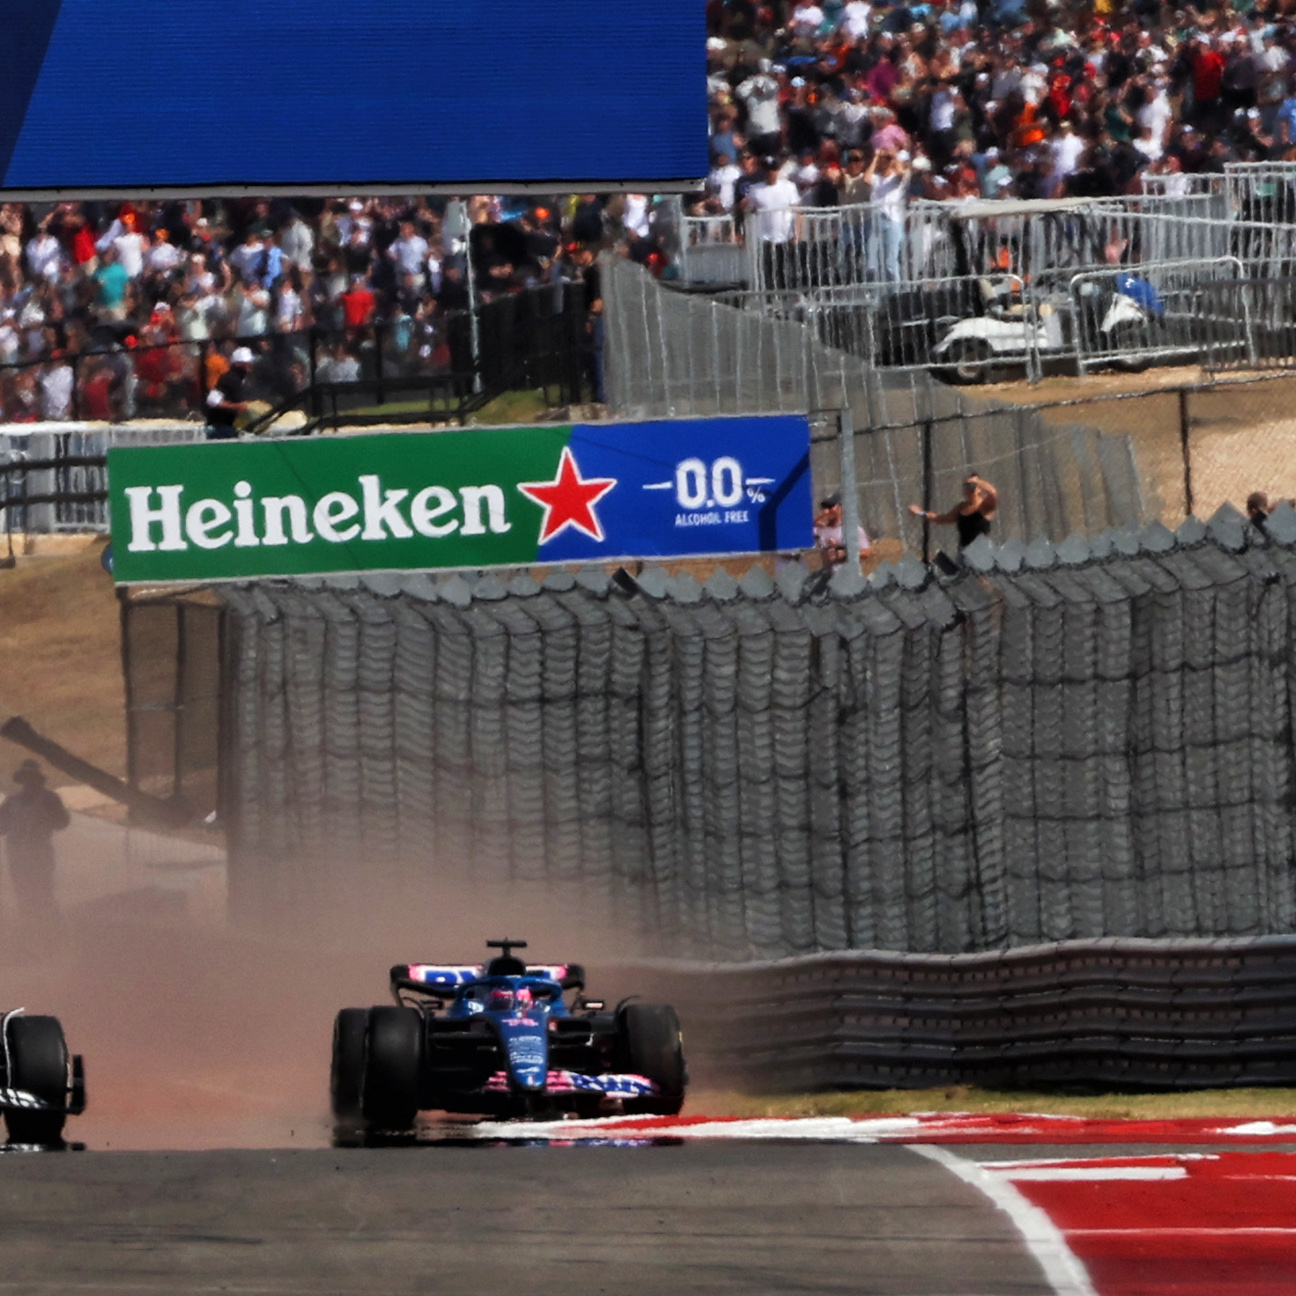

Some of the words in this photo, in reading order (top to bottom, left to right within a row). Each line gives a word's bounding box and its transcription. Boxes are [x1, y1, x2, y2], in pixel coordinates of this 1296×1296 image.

[124, 474, 512, 554] Heineken
[674, 512, 722, 526] ALCOHOL
[724, 510, 749, 524] FREE
